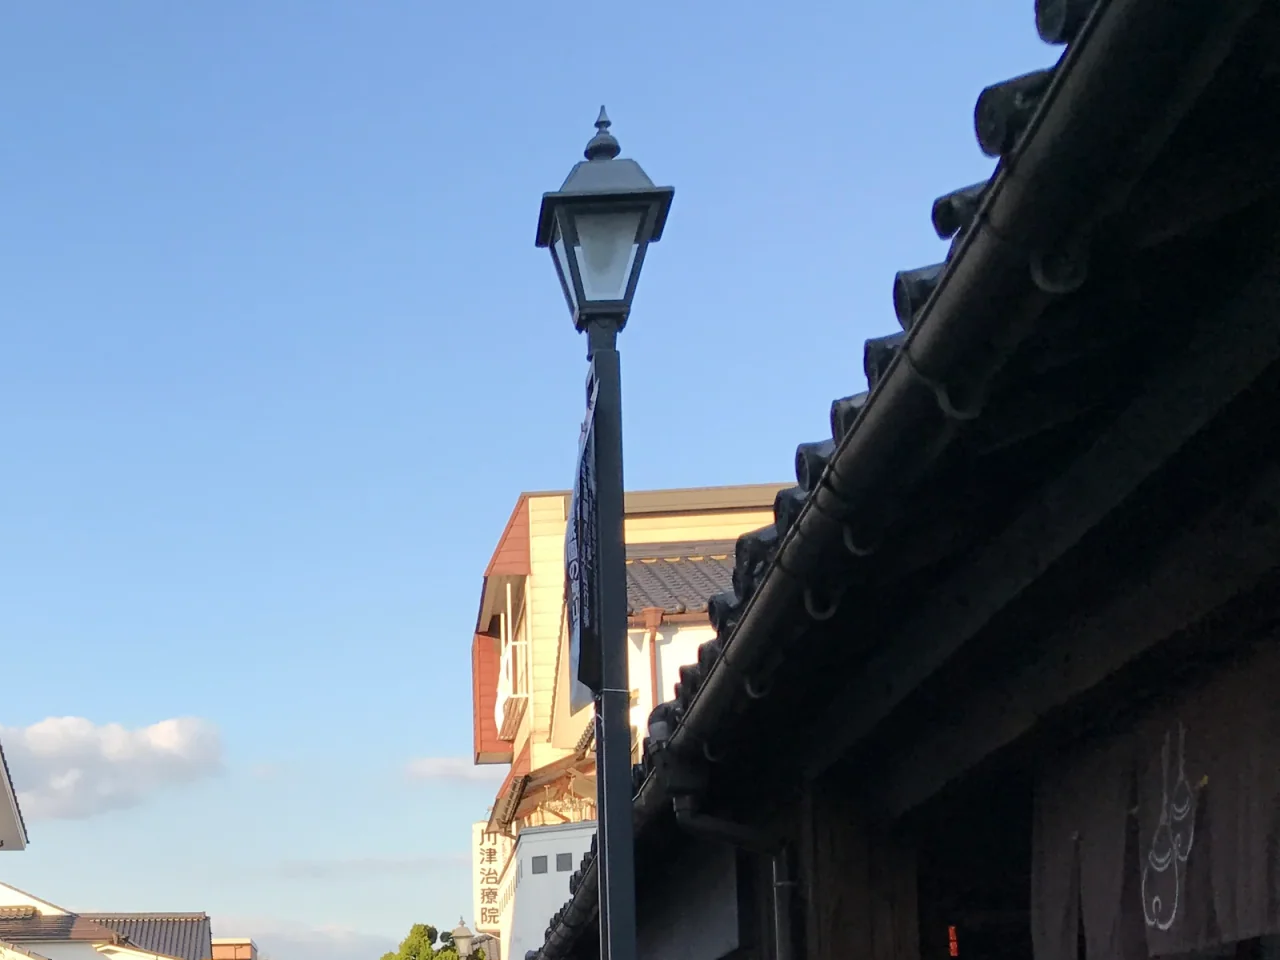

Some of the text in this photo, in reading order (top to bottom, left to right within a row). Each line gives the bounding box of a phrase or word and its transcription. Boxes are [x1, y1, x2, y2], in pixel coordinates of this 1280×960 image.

[479, 829, 500, 925] 川津治療院
